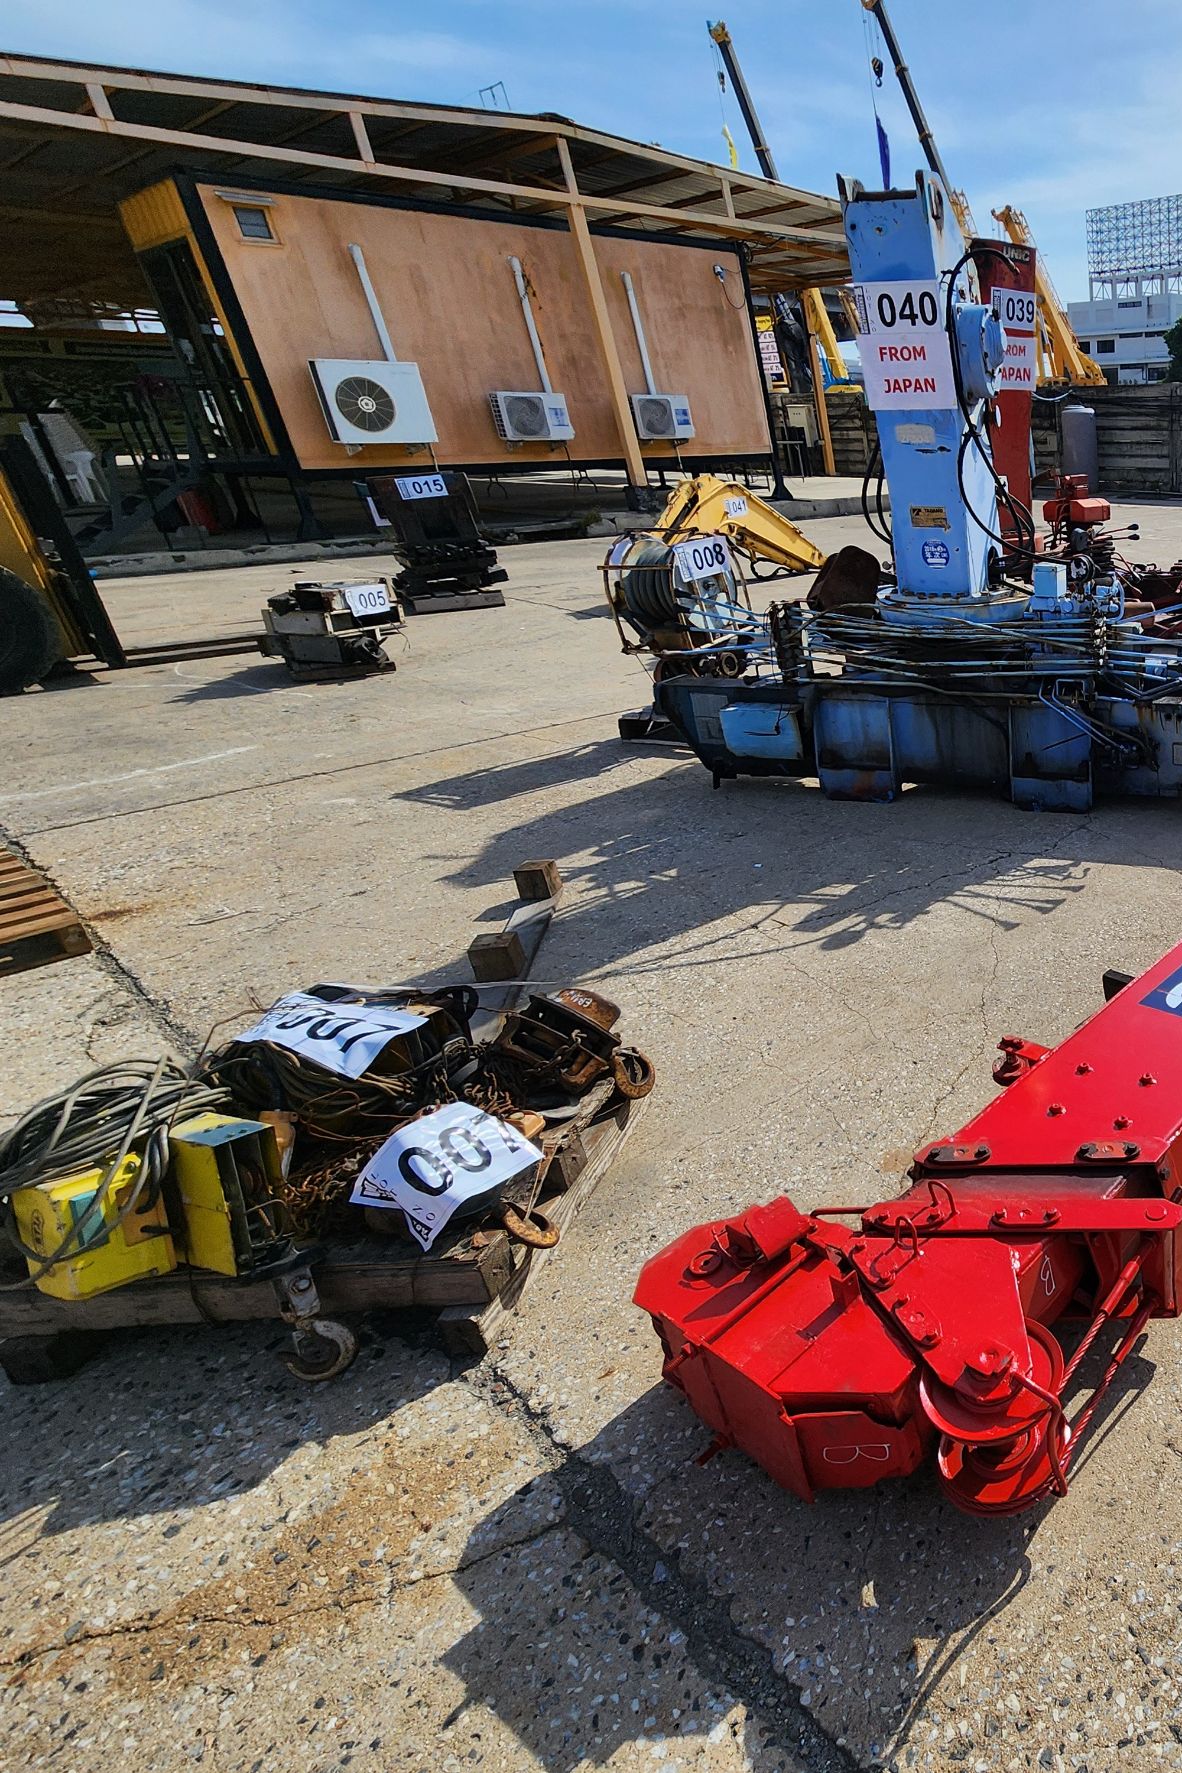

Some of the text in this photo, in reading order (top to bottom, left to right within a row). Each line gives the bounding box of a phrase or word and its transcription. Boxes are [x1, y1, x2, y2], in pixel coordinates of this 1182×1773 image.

[877, 291, 938, 328] 040
[1006, 297, 1035, 324] 039
[879, 346, 926, 362] FROM
[1003, 344, 1026, 357] ROM
[1001, 367, 1032, 382] APAN
[884, 378, 936, 394] JAPAN
[412, 479, 443, 494] 015
[732, 501, 747, 513] 041
[693, 543, 726, 570] 008
[359, 591, 386, 608] 005
